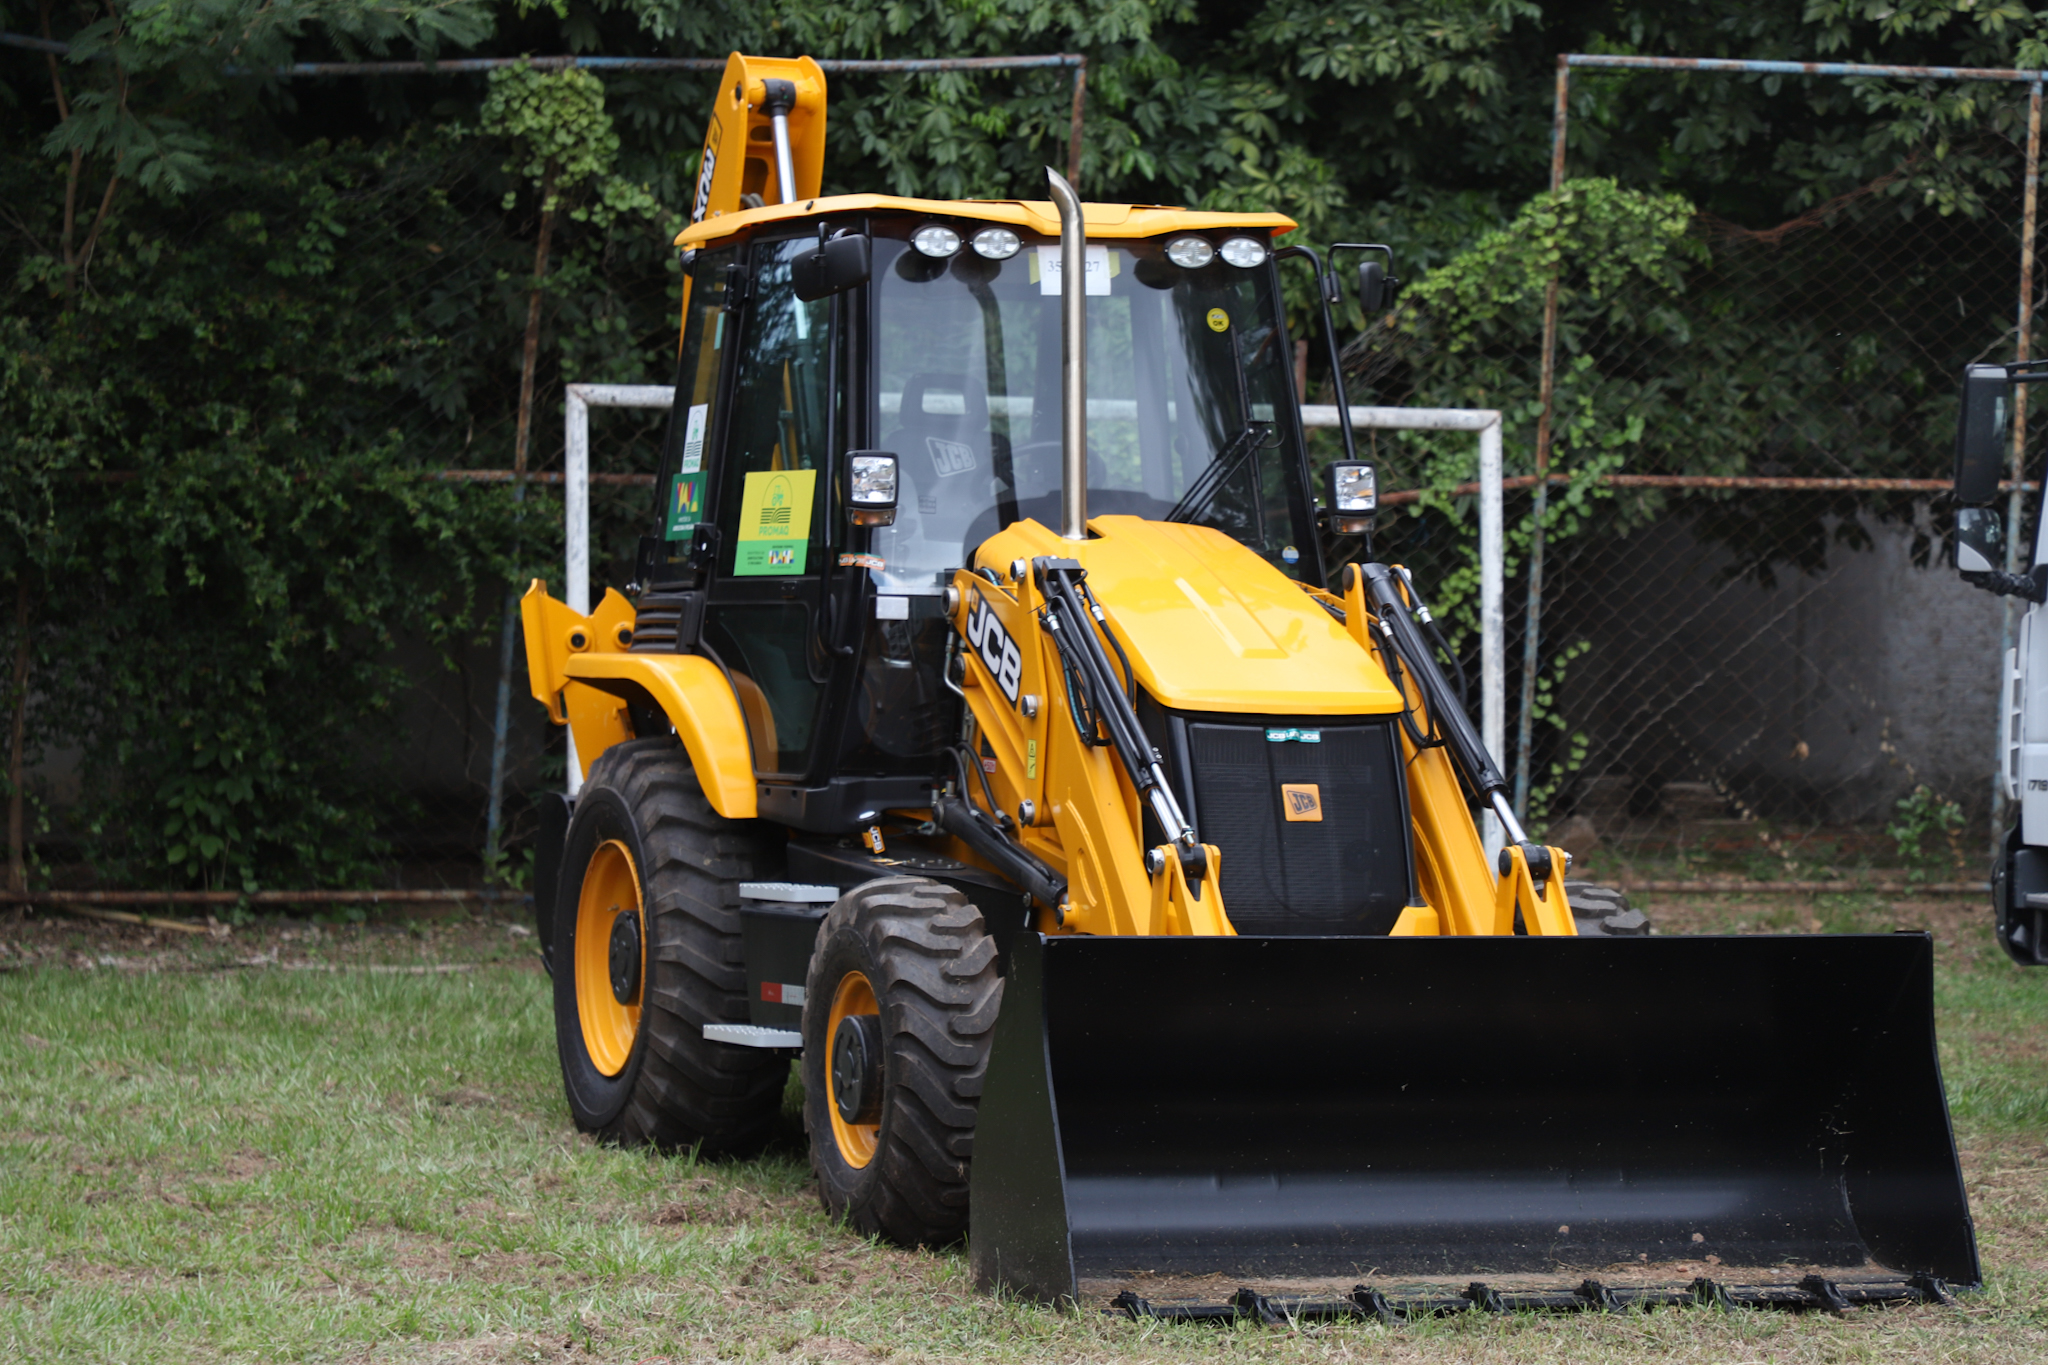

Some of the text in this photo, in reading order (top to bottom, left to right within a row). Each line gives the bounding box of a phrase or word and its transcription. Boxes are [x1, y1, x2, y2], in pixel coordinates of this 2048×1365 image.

[935, 441, 973, 473] JCB
[758, 525, 790, 537] PROMAQ
[967, 601, 1022, 702] JCB
[1292, 793, 1316, 812] JCB
[870, 826, 883, 851] JCB
